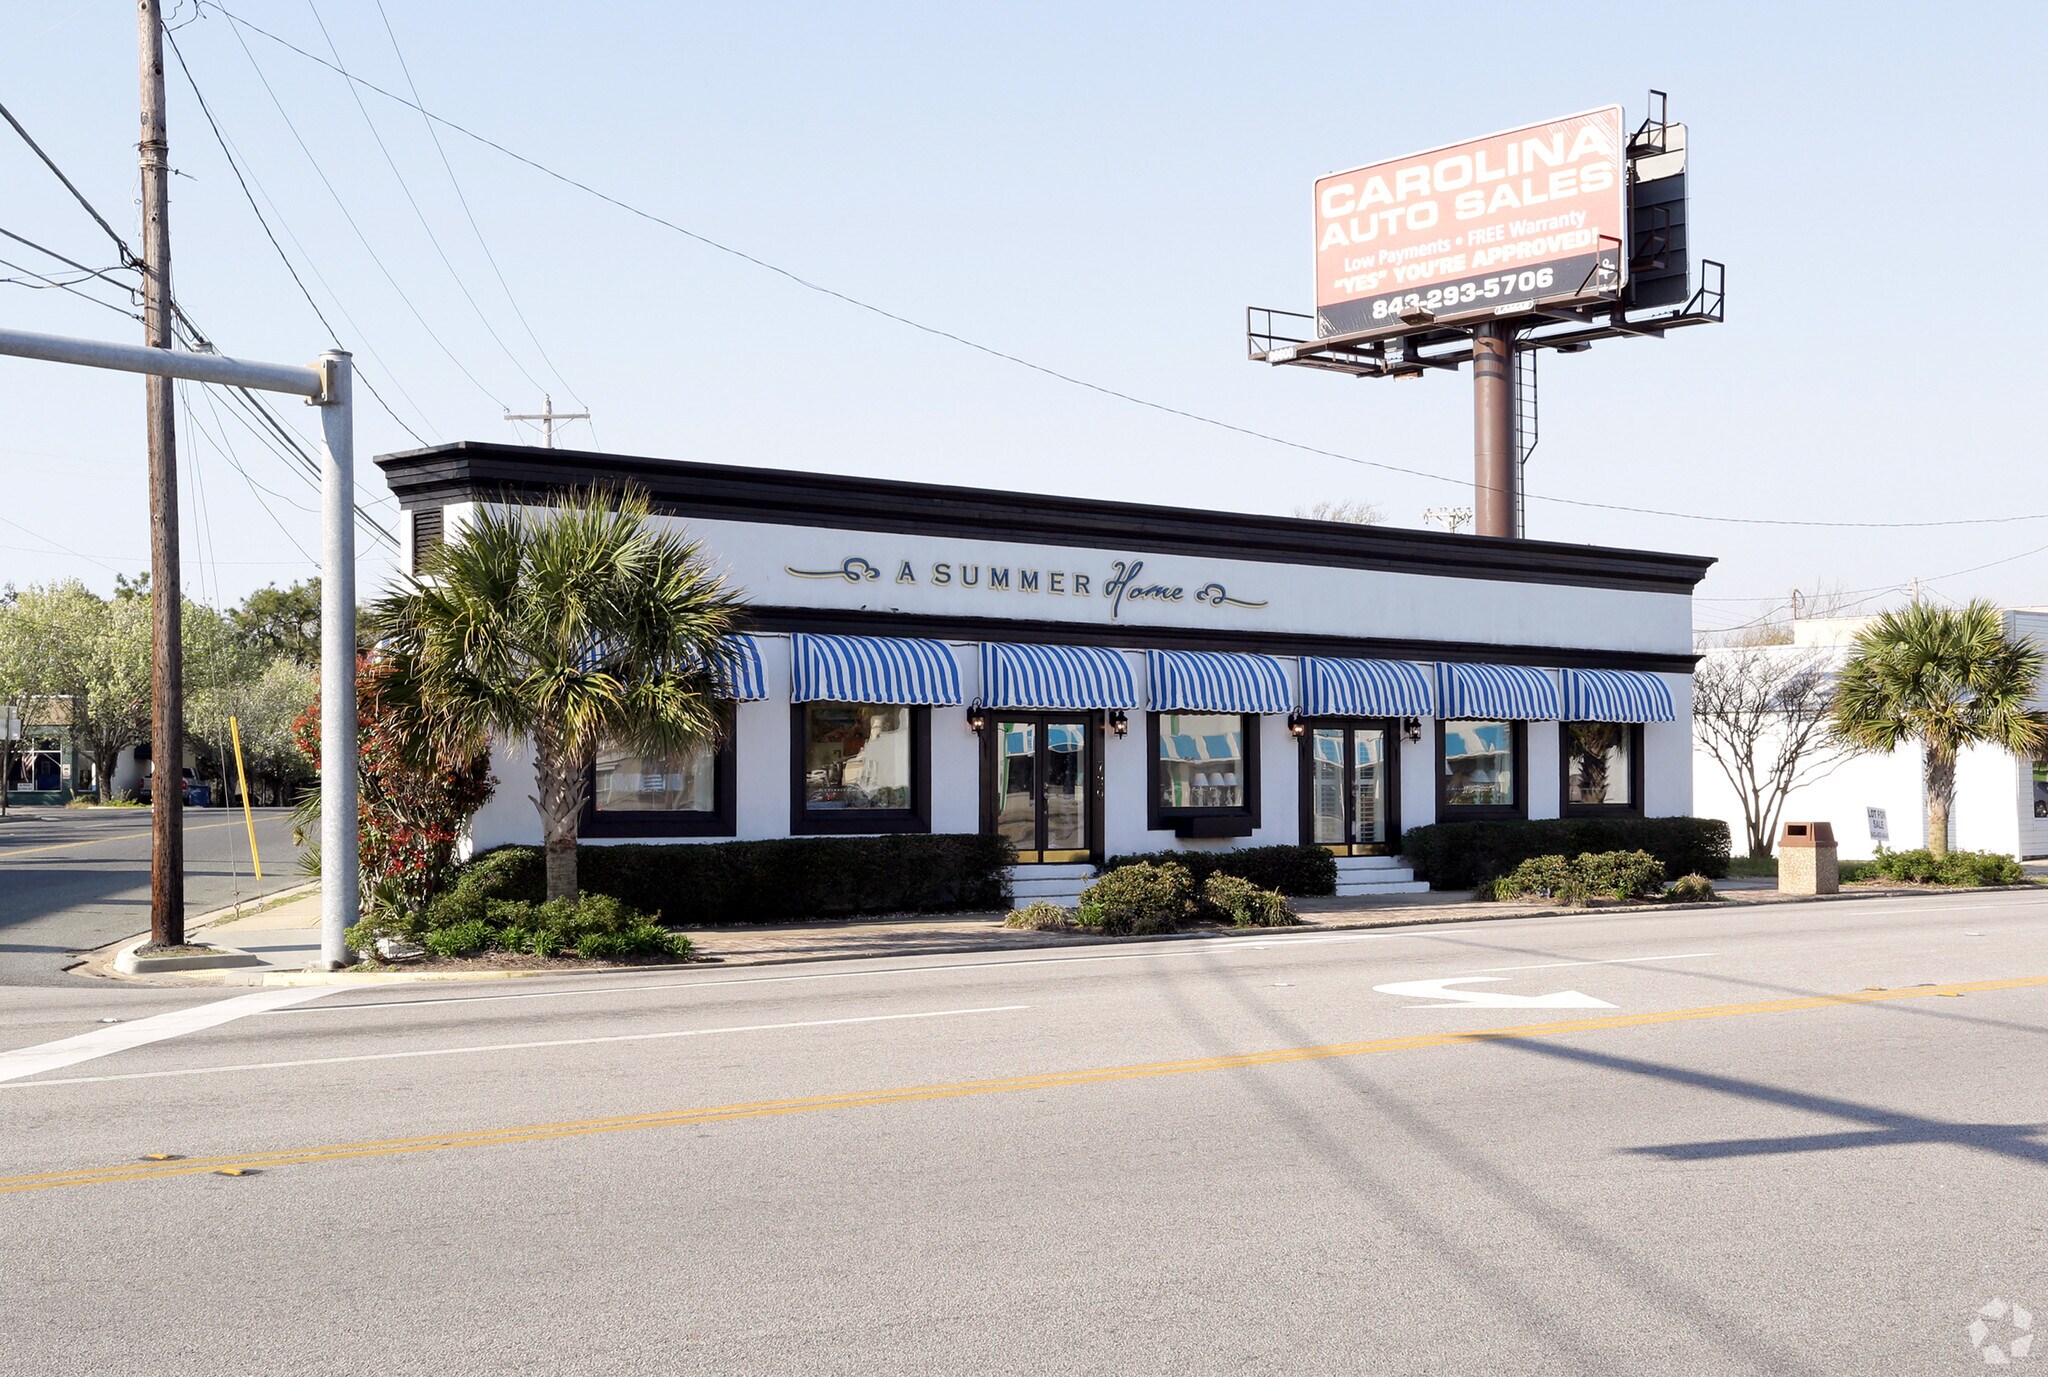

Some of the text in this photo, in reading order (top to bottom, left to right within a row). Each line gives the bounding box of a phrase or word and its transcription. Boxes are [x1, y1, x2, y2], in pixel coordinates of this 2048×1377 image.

[1321, 124, 1611, 219] CAROLINA
[1319, 161, 1615, 251] AUTO SALES
[1344, 210, 1587, 273] Low Payments FREE Warranty
[1392, 254, 1467, 284] YOU'RE
[1472, 226, 1598, 268] APPROVED!
[1371, 267, 1554, 320] 843-293-5706
[895, 559, 1184, 620] A SUMMER Home
[1872, 819, 1885, 829] SALE
